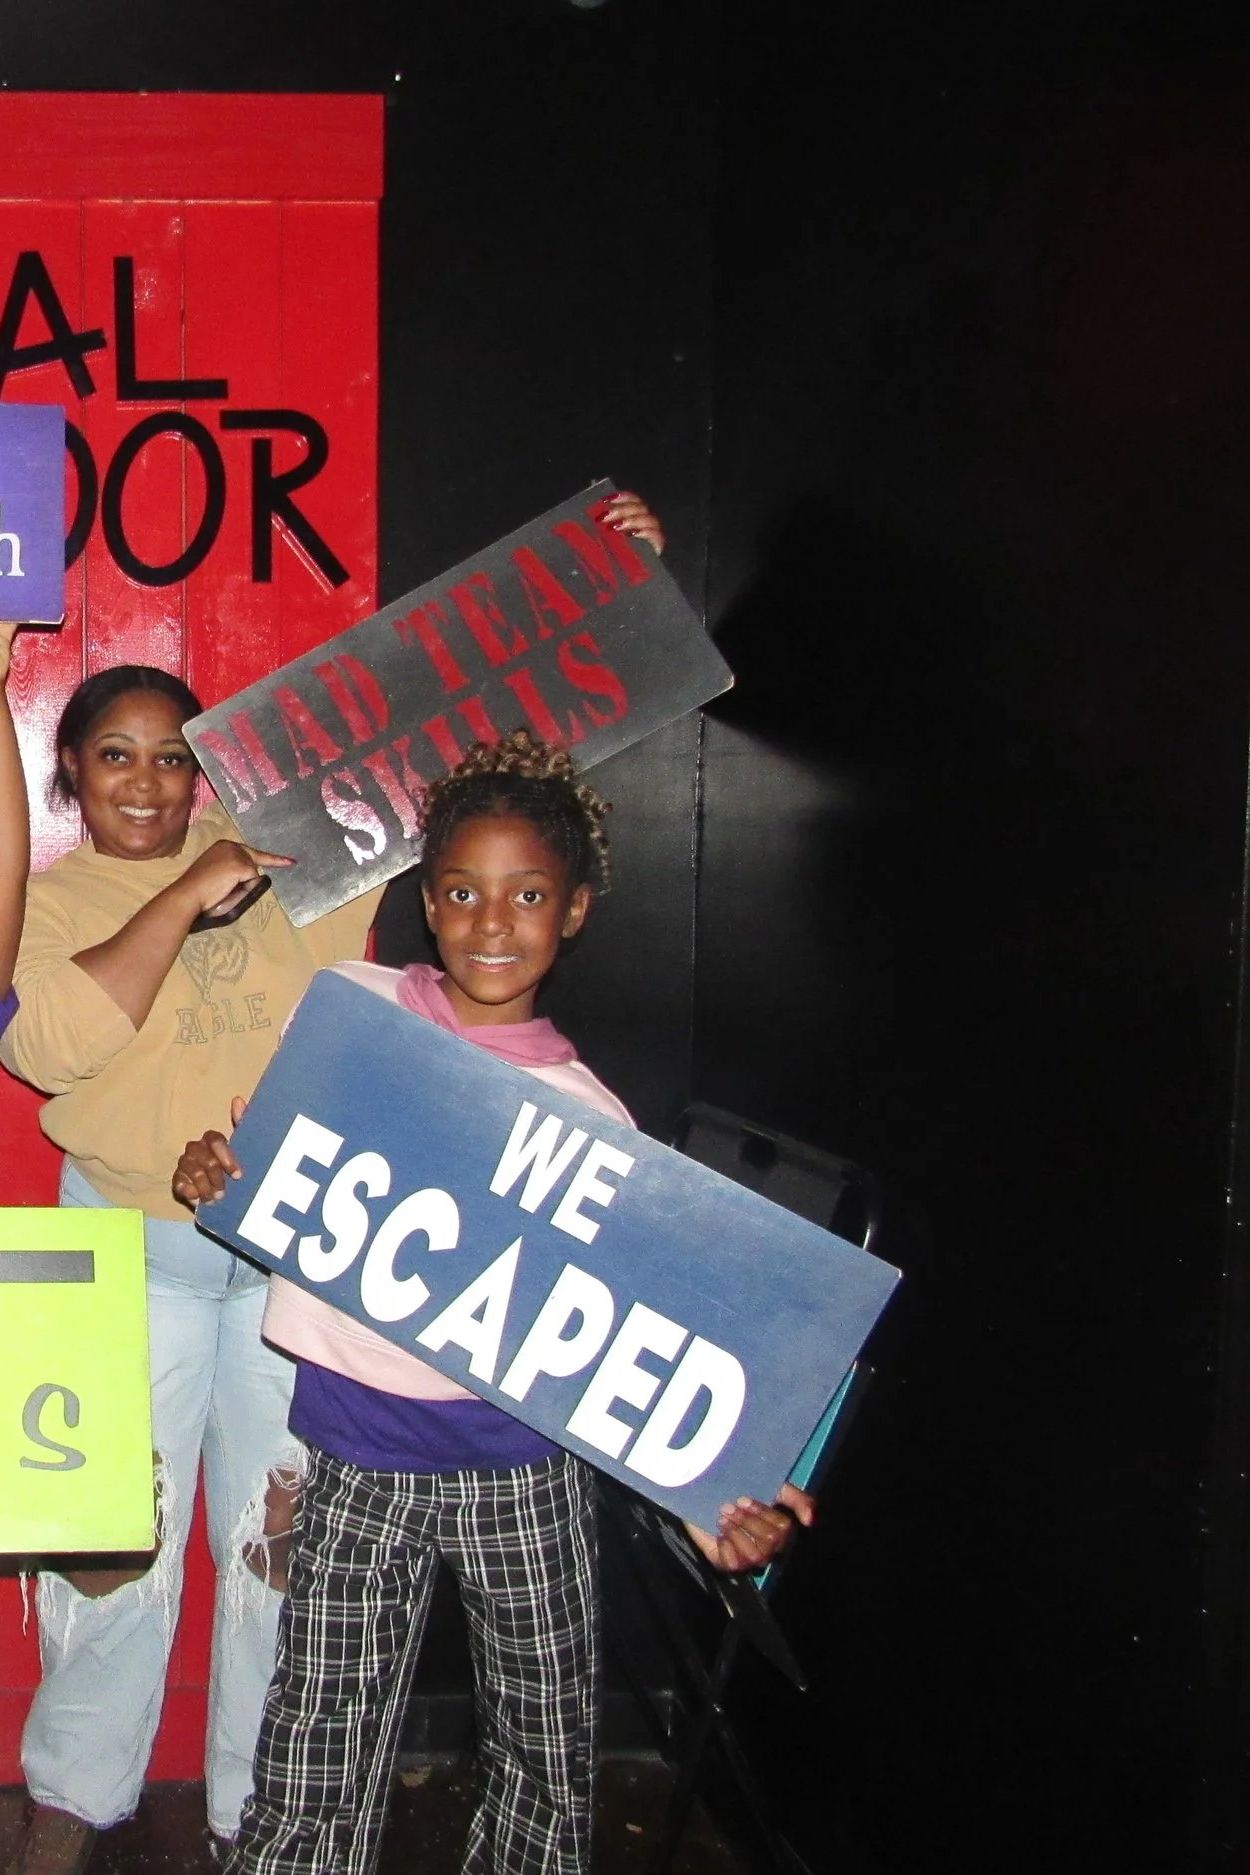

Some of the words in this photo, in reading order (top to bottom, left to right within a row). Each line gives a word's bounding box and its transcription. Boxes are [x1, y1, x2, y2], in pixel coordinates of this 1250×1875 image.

[64, 409, 350, 589] OR
[195, 653, 390, 814] MAD
[393, 499, 653, 694] TEAM
[488, 1100, 636, 1244] WE
[236, 1113, 746, 1488] ESCAPED
